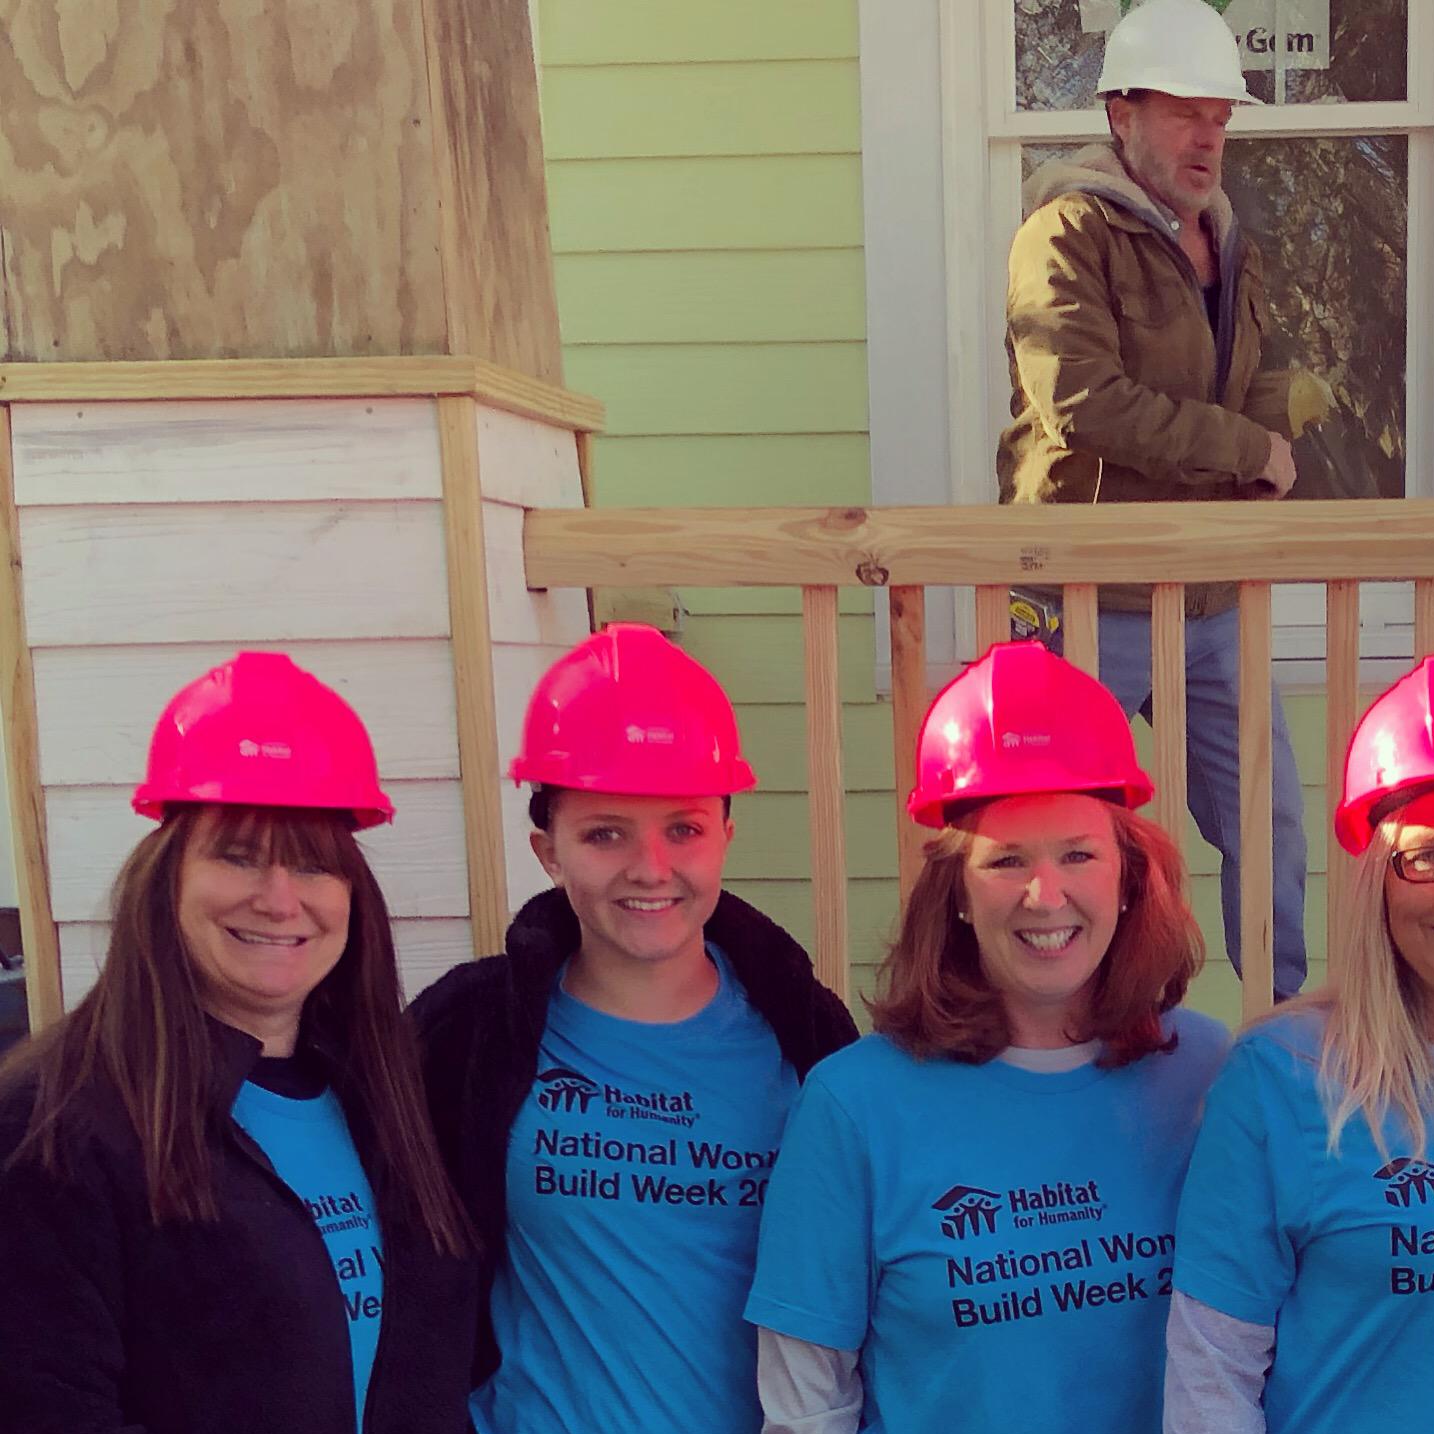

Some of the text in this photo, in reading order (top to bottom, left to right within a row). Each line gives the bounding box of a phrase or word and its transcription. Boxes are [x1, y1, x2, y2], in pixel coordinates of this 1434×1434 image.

[604, 1083, 694, 1112] Habitat
[606, 1106, 626, 1119] for
[534, 1129, 677, 1165] National
[535, 1166, 620, 1200] Build
[632, 1173, 729, 1207] Week
[1008, 1180, 1101, 1213] Habitat
[1014, 1214, 1035, 1229] for
[947, 1239, 1093, 1288] National
[952, 1287, 1043, 1328] Build
[1051, 1272, 1148, 1312] Week
